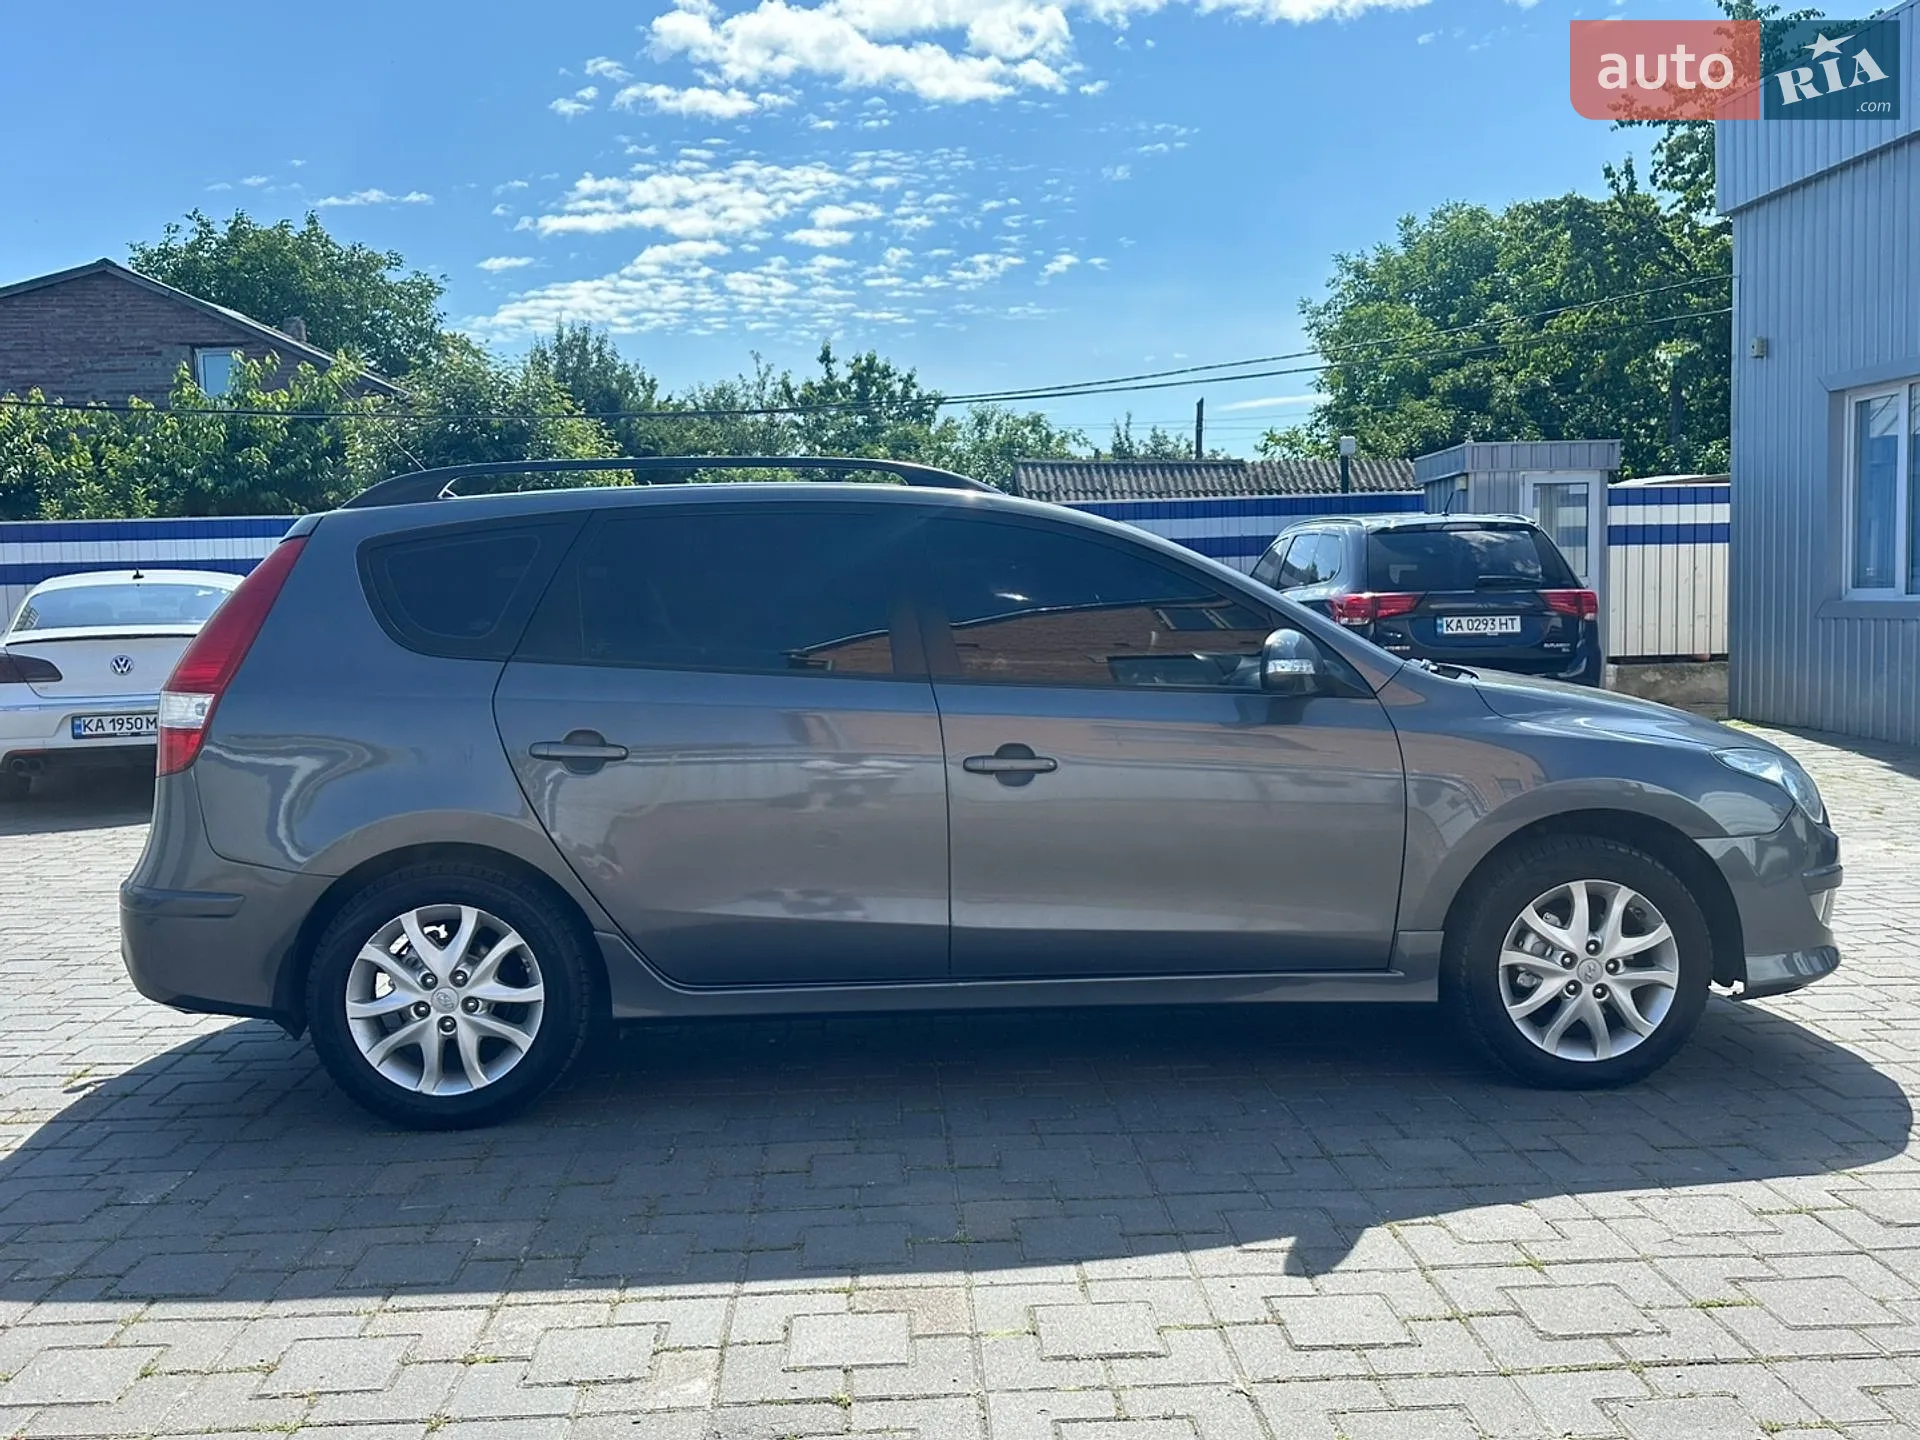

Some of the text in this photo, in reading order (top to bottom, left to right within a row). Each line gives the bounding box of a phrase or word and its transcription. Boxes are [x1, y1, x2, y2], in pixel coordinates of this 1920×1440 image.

[1445, 618, 1517, 632] KA 0293 HT
[83, 716, 158, 732] KA 1950 M
